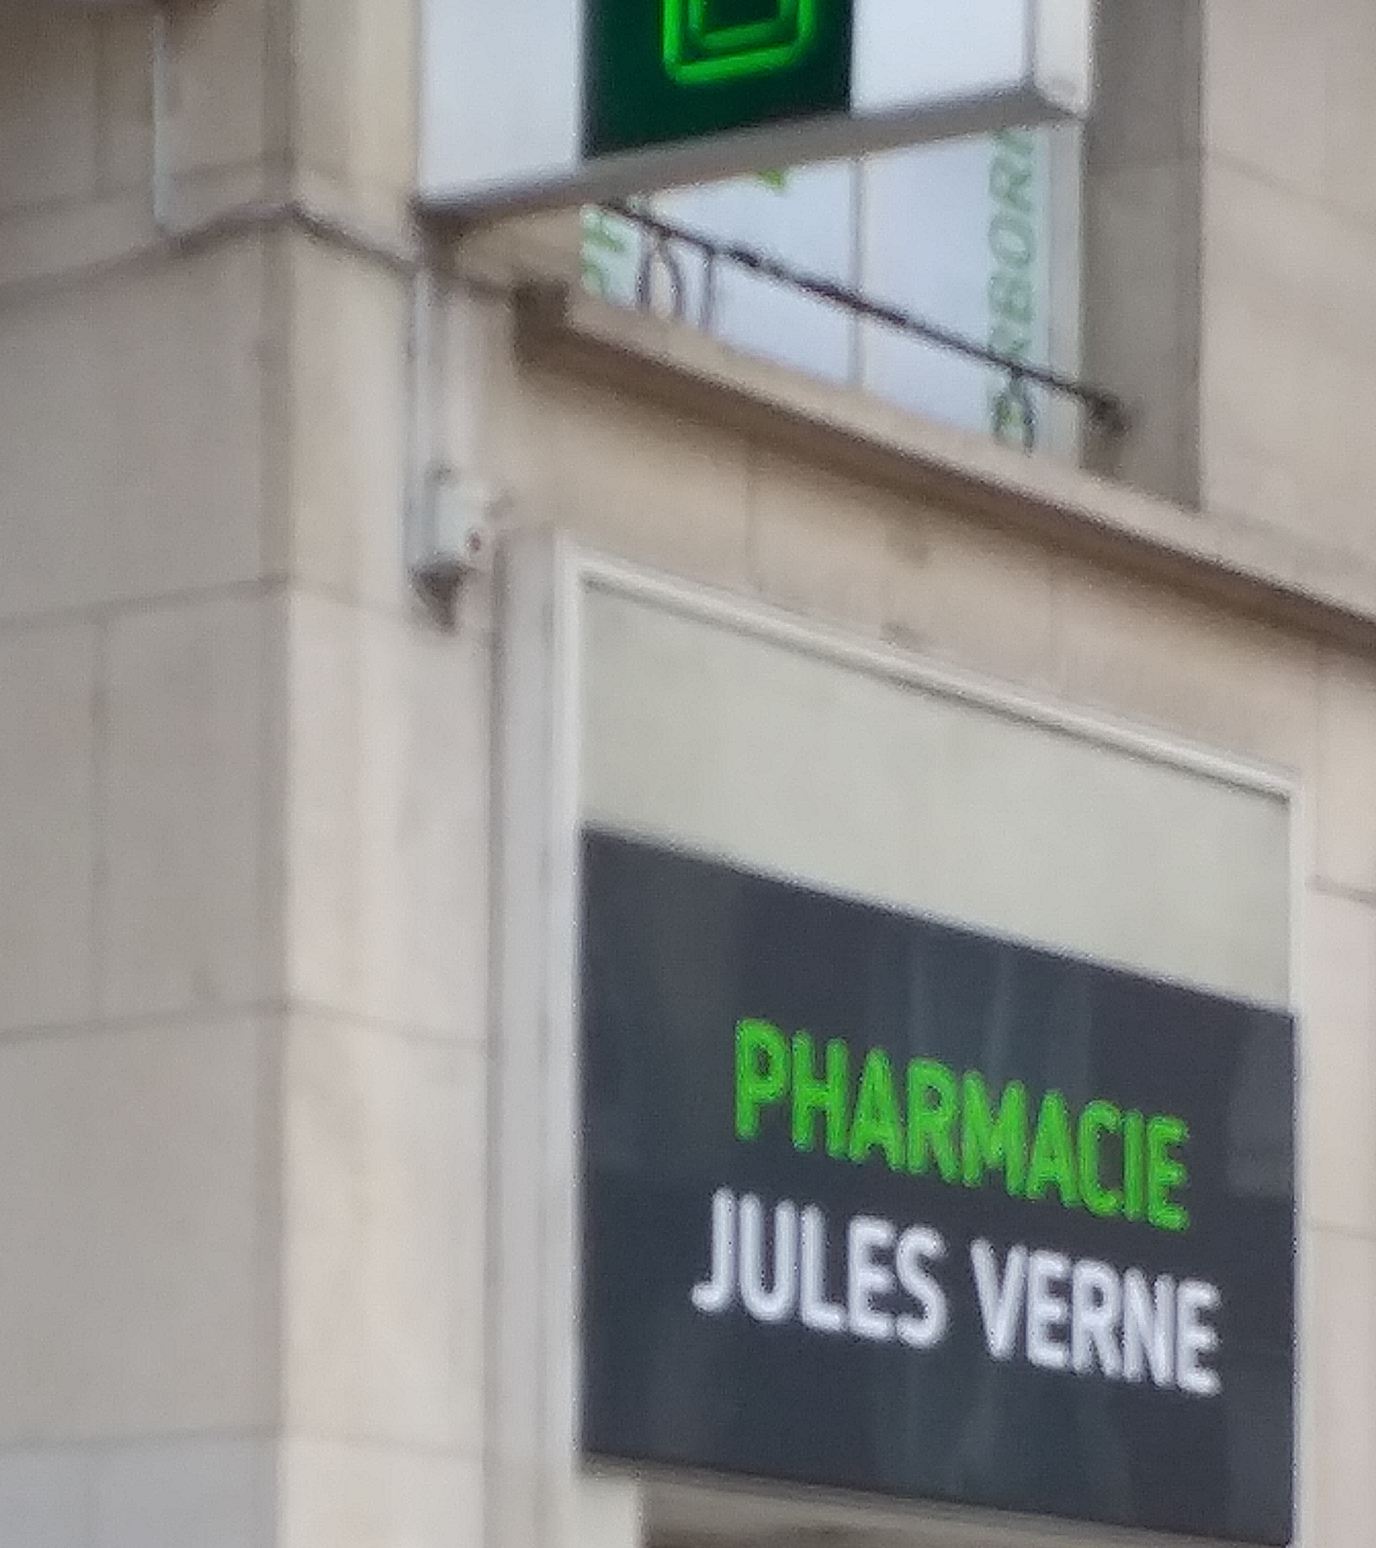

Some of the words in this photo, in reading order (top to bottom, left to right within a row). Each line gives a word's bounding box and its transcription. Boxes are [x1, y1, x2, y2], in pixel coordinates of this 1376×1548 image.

[734, 1017, 1191, 1233] PHARMACIE
[690, 1186, 951, 1350] JULES
[969, 1236, 1225, 1398] VERNE
